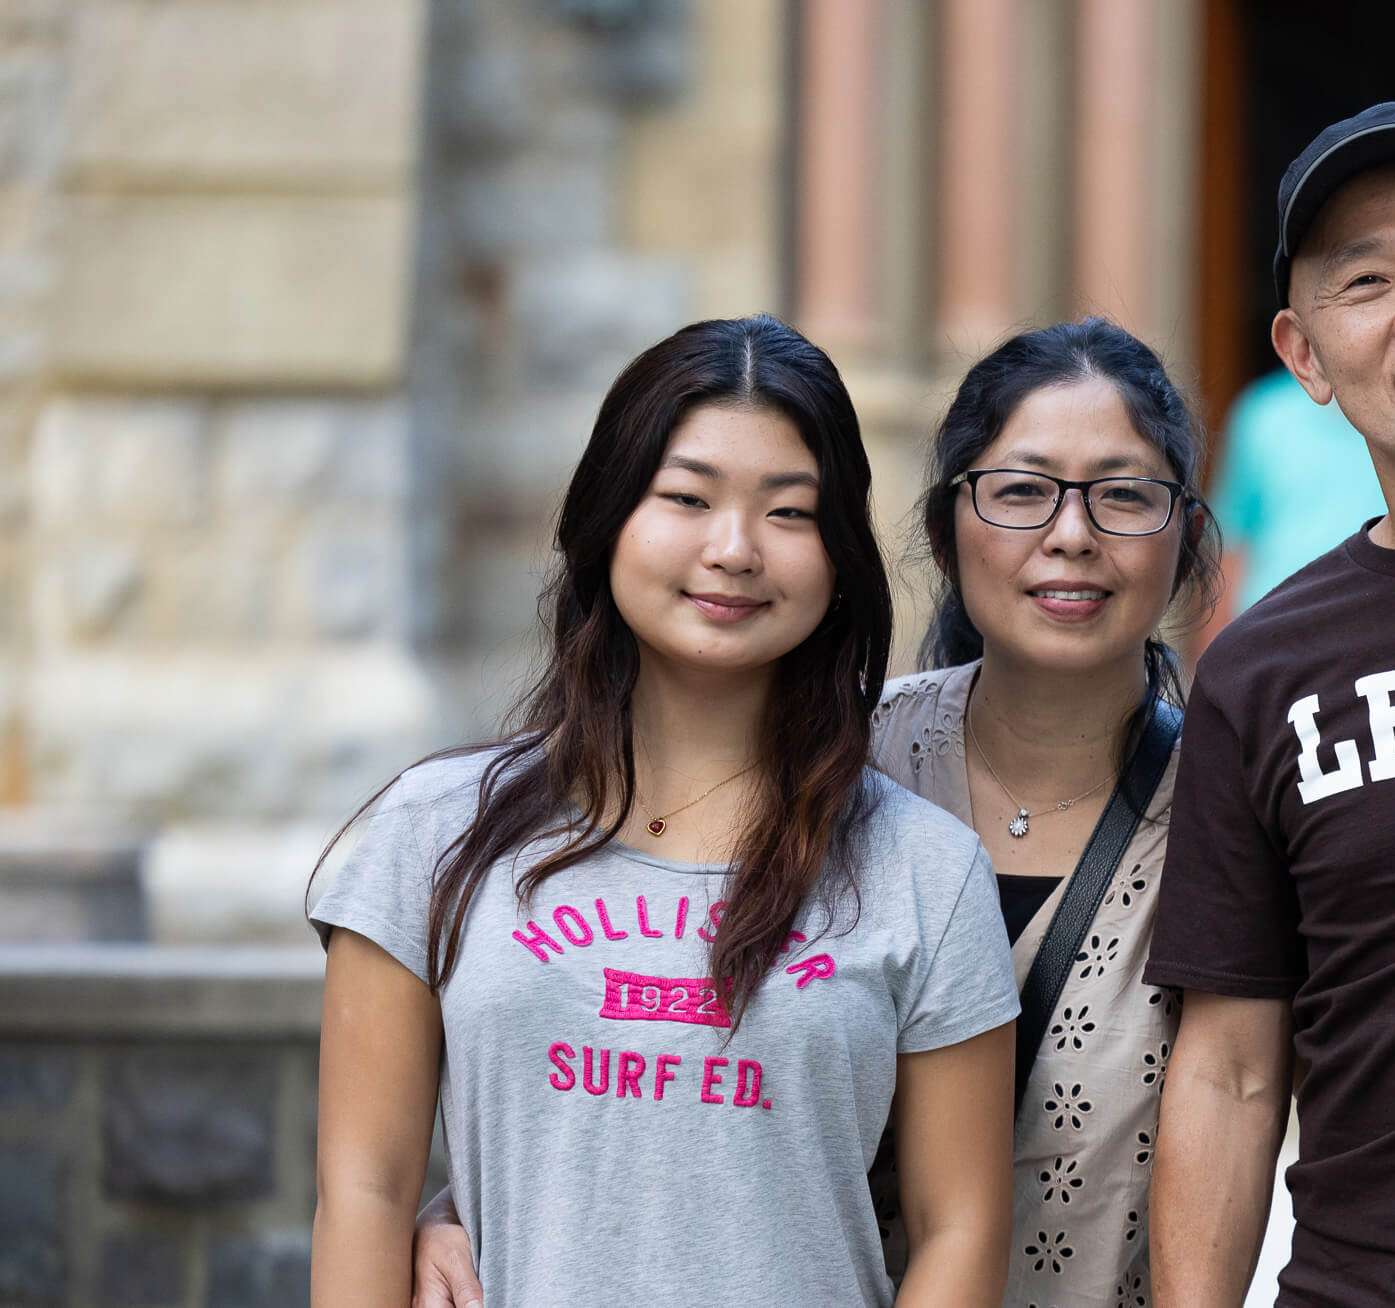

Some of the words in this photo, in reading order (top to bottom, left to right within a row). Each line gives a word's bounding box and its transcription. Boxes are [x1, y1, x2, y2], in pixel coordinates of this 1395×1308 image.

[511, 895, 837, 990] HOLLISR
[617, 983, 719, 1015] 1922
[547, 1041, 682, 1101] SURF
[700, 1055, 772, 1110] ED.
